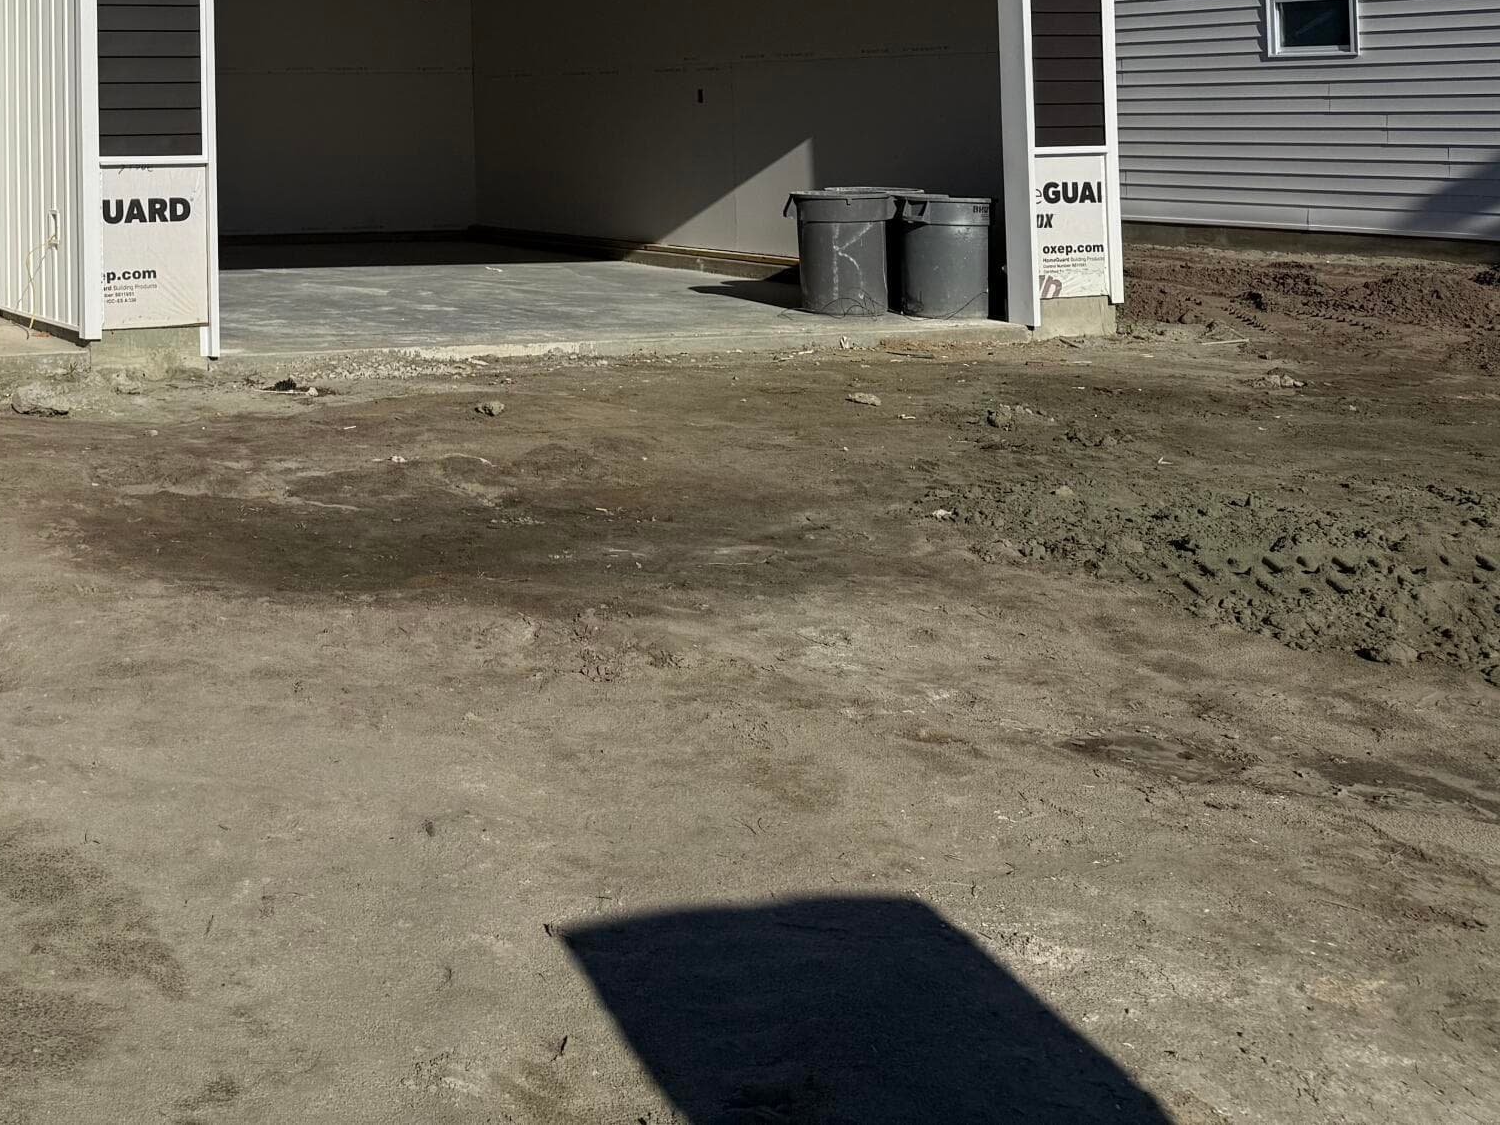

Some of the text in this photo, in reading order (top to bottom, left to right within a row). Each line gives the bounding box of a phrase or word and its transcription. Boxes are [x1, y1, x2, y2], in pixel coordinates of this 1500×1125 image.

[103, 197, 191, 224] UARD
[1043, 244, 1104, 255] oxep.com
[103, 269, 157, 284] p.com
